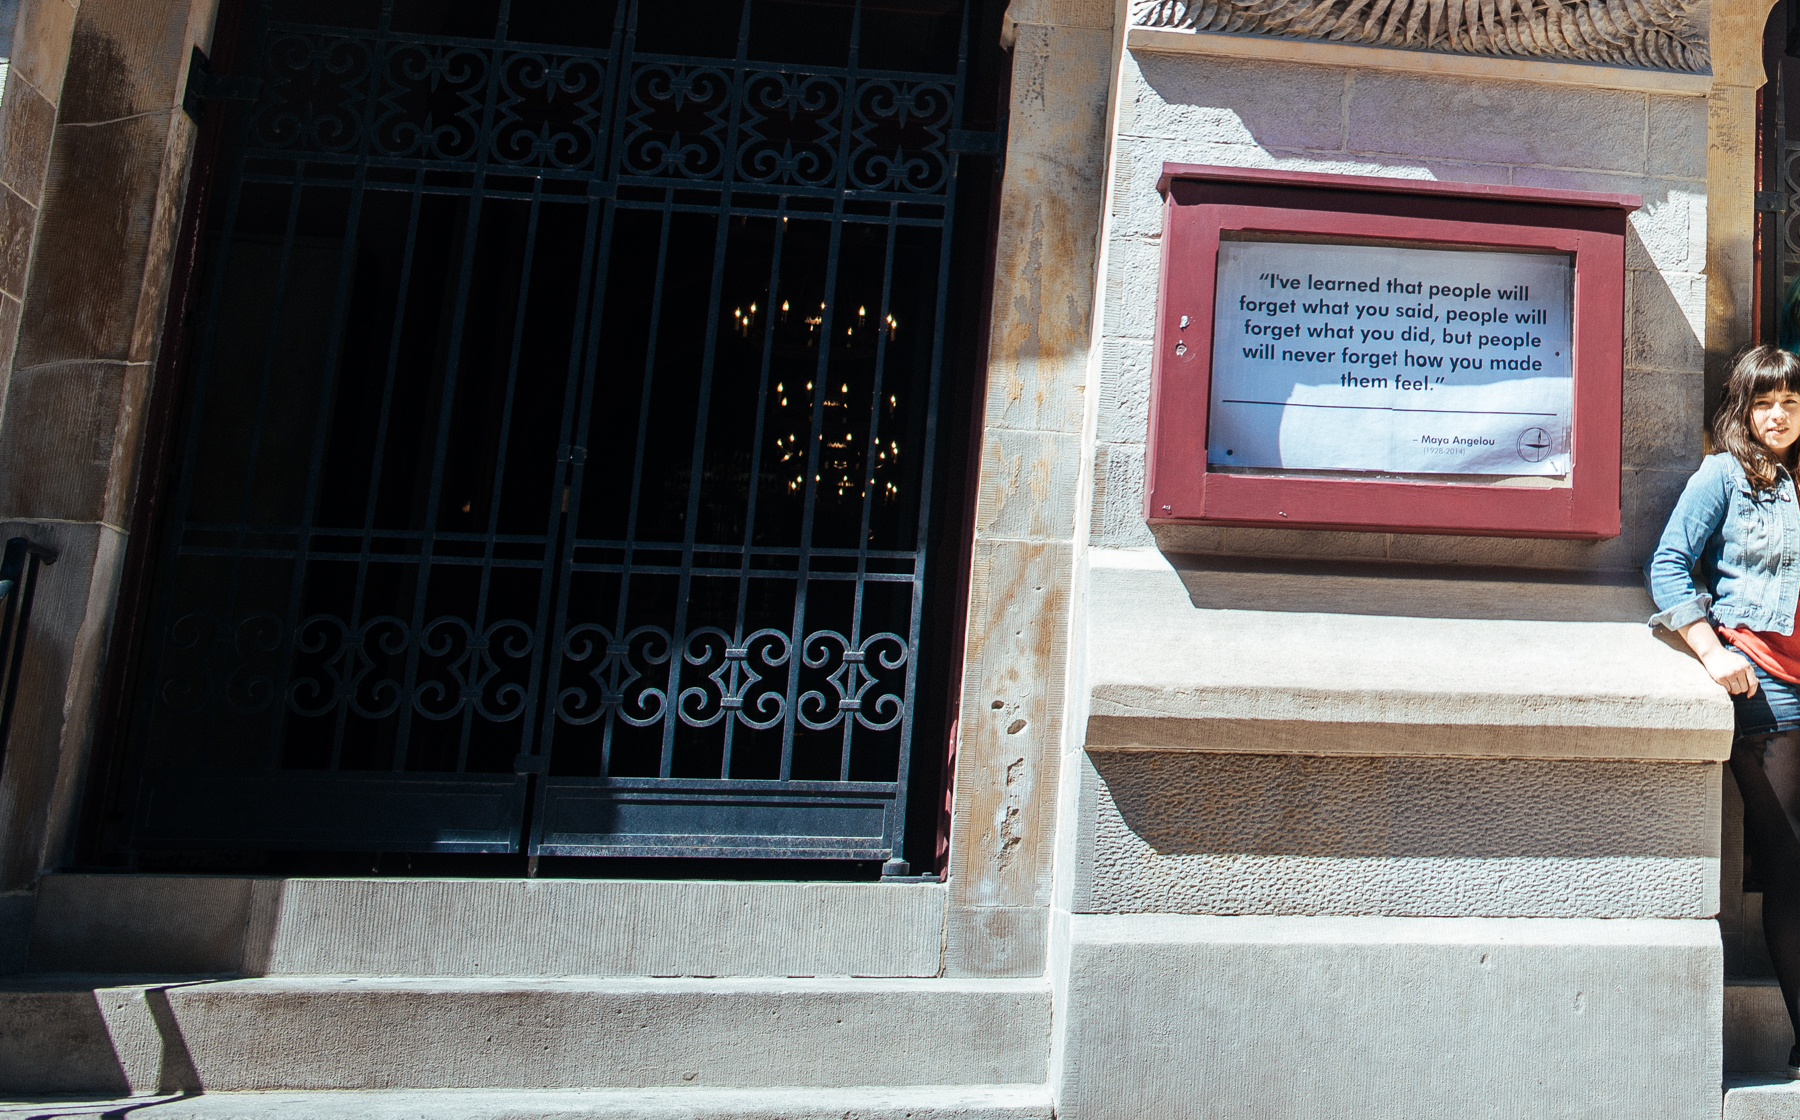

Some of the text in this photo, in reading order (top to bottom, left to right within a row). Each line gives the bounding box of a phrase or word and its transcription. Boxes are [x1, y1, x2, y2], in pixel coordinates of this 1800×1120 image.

[1307, 274, 1380, 293] learned
[1387, 277, 1423, 295] that
[1428, 282, 1492, 302] people
[1497, 285, 1529, 301] will
[1239, 295, 1547, 326] forget what you said, people will
[1244, 319, 1542, 351] forget what you did, but people
[1242, 343, 1543, 373] will never forget how you made
[1340, 371, 1388, 388] them
[1421, 435, 1450, 447] Maya
[1452, 435, 1496, 448] Angelou
[1423, 447, 1466, 456] (1928-2014)
